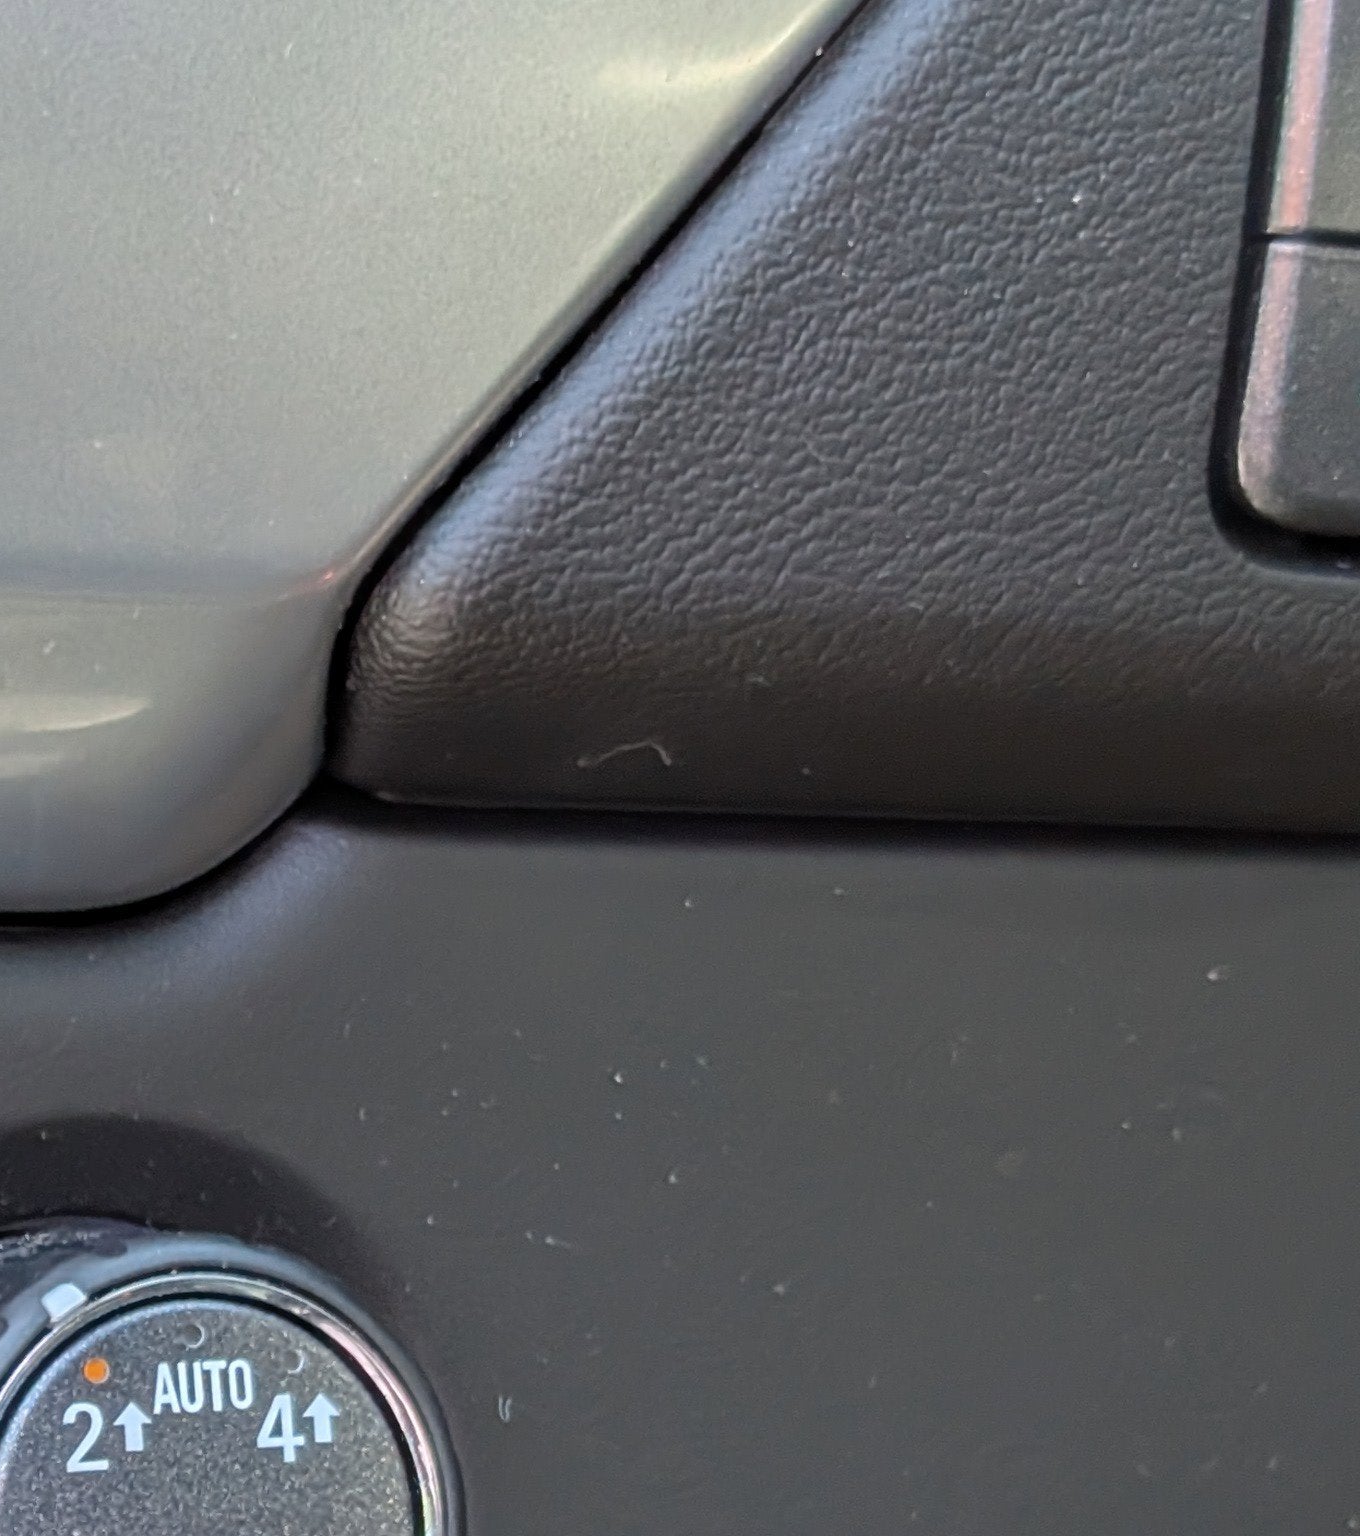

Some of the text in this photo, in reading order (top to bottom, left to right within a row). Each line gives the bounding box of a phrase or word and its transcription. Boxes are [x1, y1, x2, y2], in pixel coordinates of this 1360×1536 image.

[153, 1359, 254, 1414] AUTO
[62, 1402, 109, 1473] 2
[256, 1393, 305, 1463] 4
